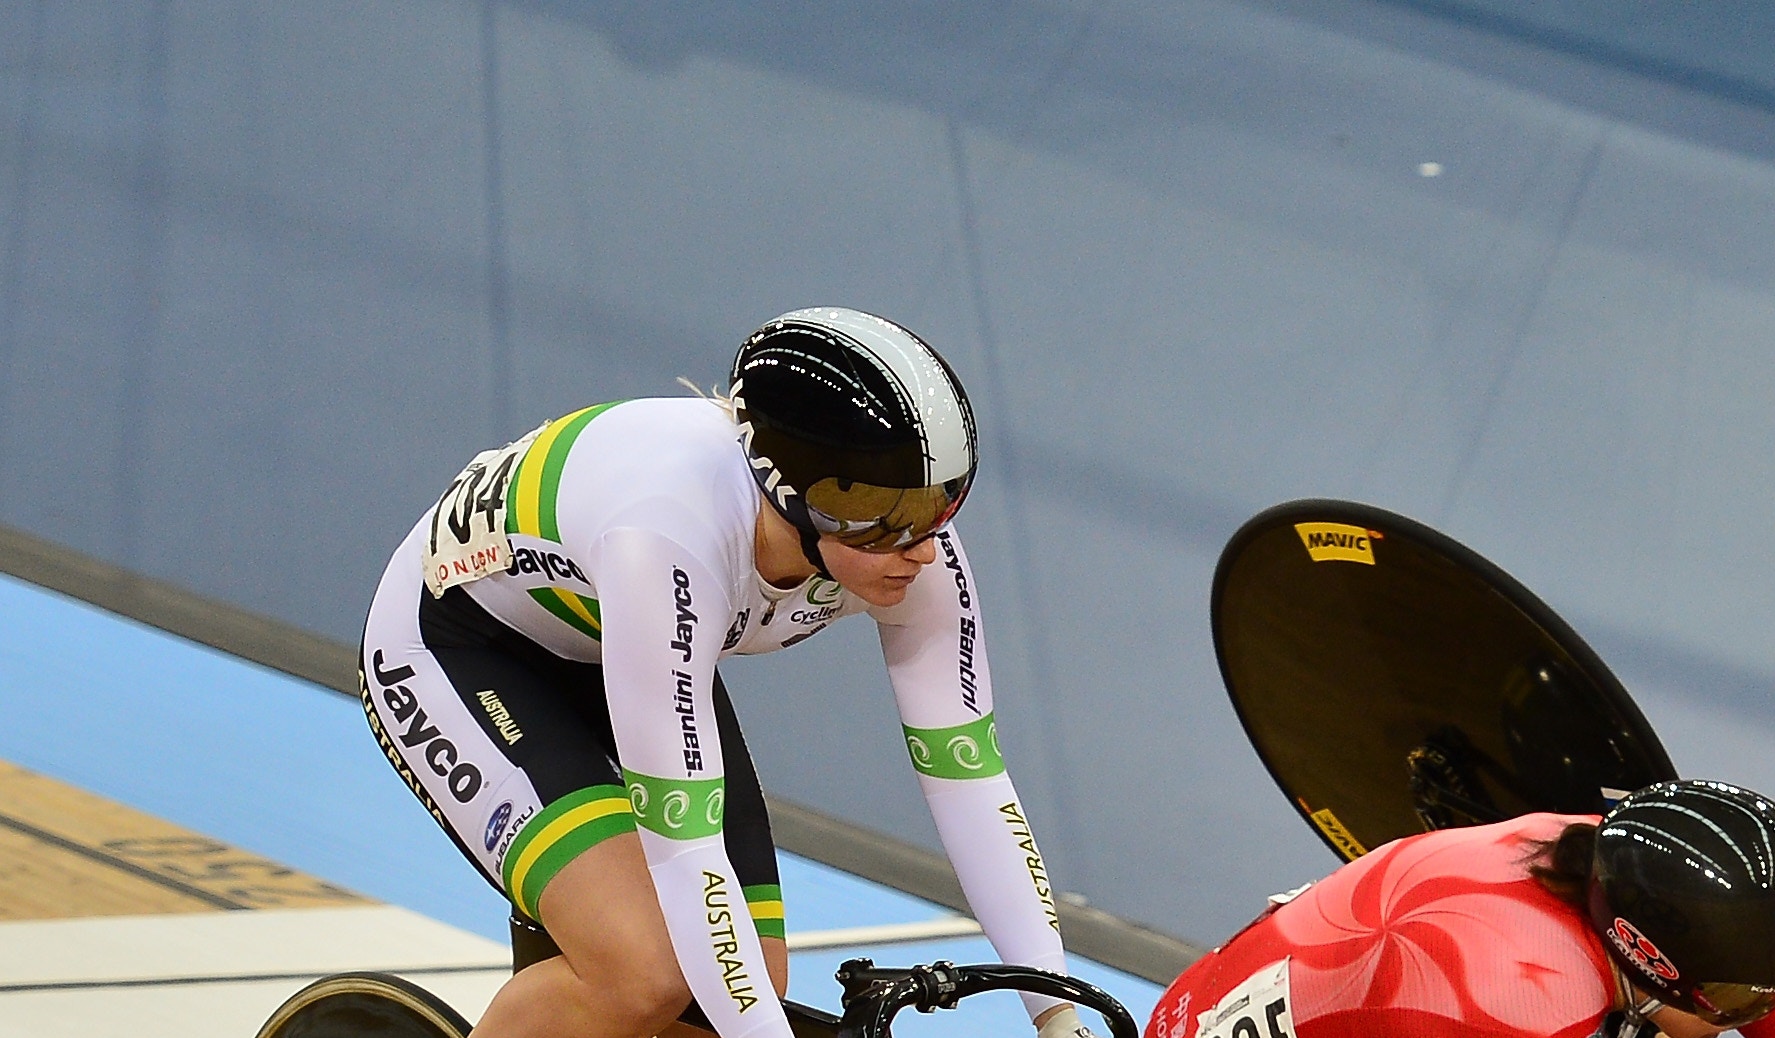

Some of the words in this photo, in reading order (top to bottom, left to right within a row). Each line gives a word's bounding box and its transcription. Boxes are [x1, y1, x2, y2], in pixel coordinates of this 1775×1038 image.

[505, 539, 591, 585] Jayco
[1307, 531, 1367, 552] MAVIC
[671, 566, 698, 662] Jayco
[937, 530, 971, 609] Jayco
[958, 616, 982, 717] Santini
[372, 648, 482, 804] Jayco
[475, 689, 524, 746] AUSTRALIA
[672, 667, 704, 773] Santini
[702, 870, 758, 1014] AUSTRALIA
